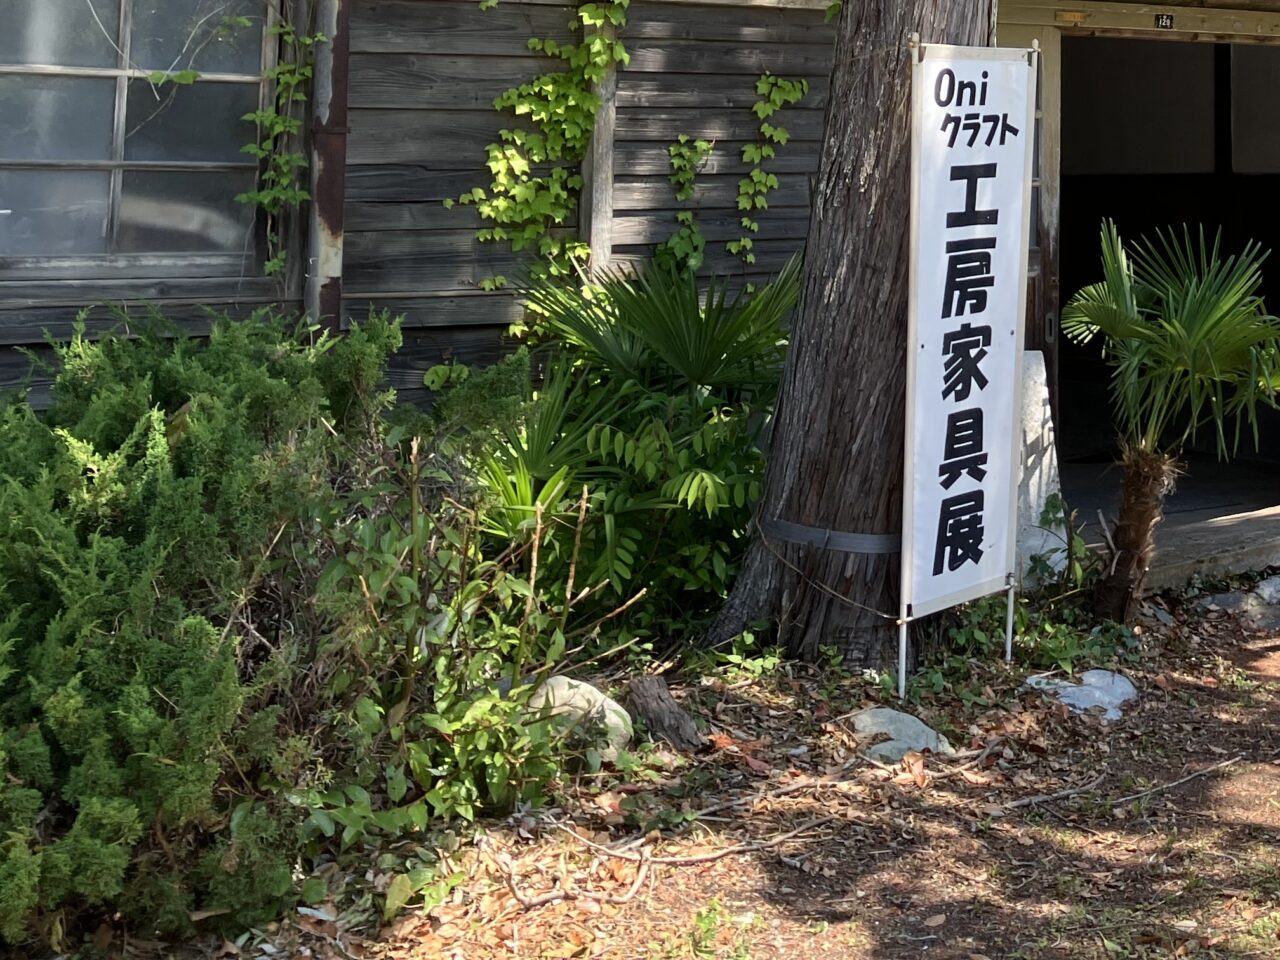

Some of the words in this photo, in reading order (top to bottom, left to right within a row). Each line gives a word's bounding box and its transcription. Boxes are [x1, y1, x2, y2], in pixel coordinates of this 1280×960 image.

[934, 68, 989, 107] Oni
[940, 113, 1019, 148] クラフト
[932, 162, 999, 576] 工房家具展
